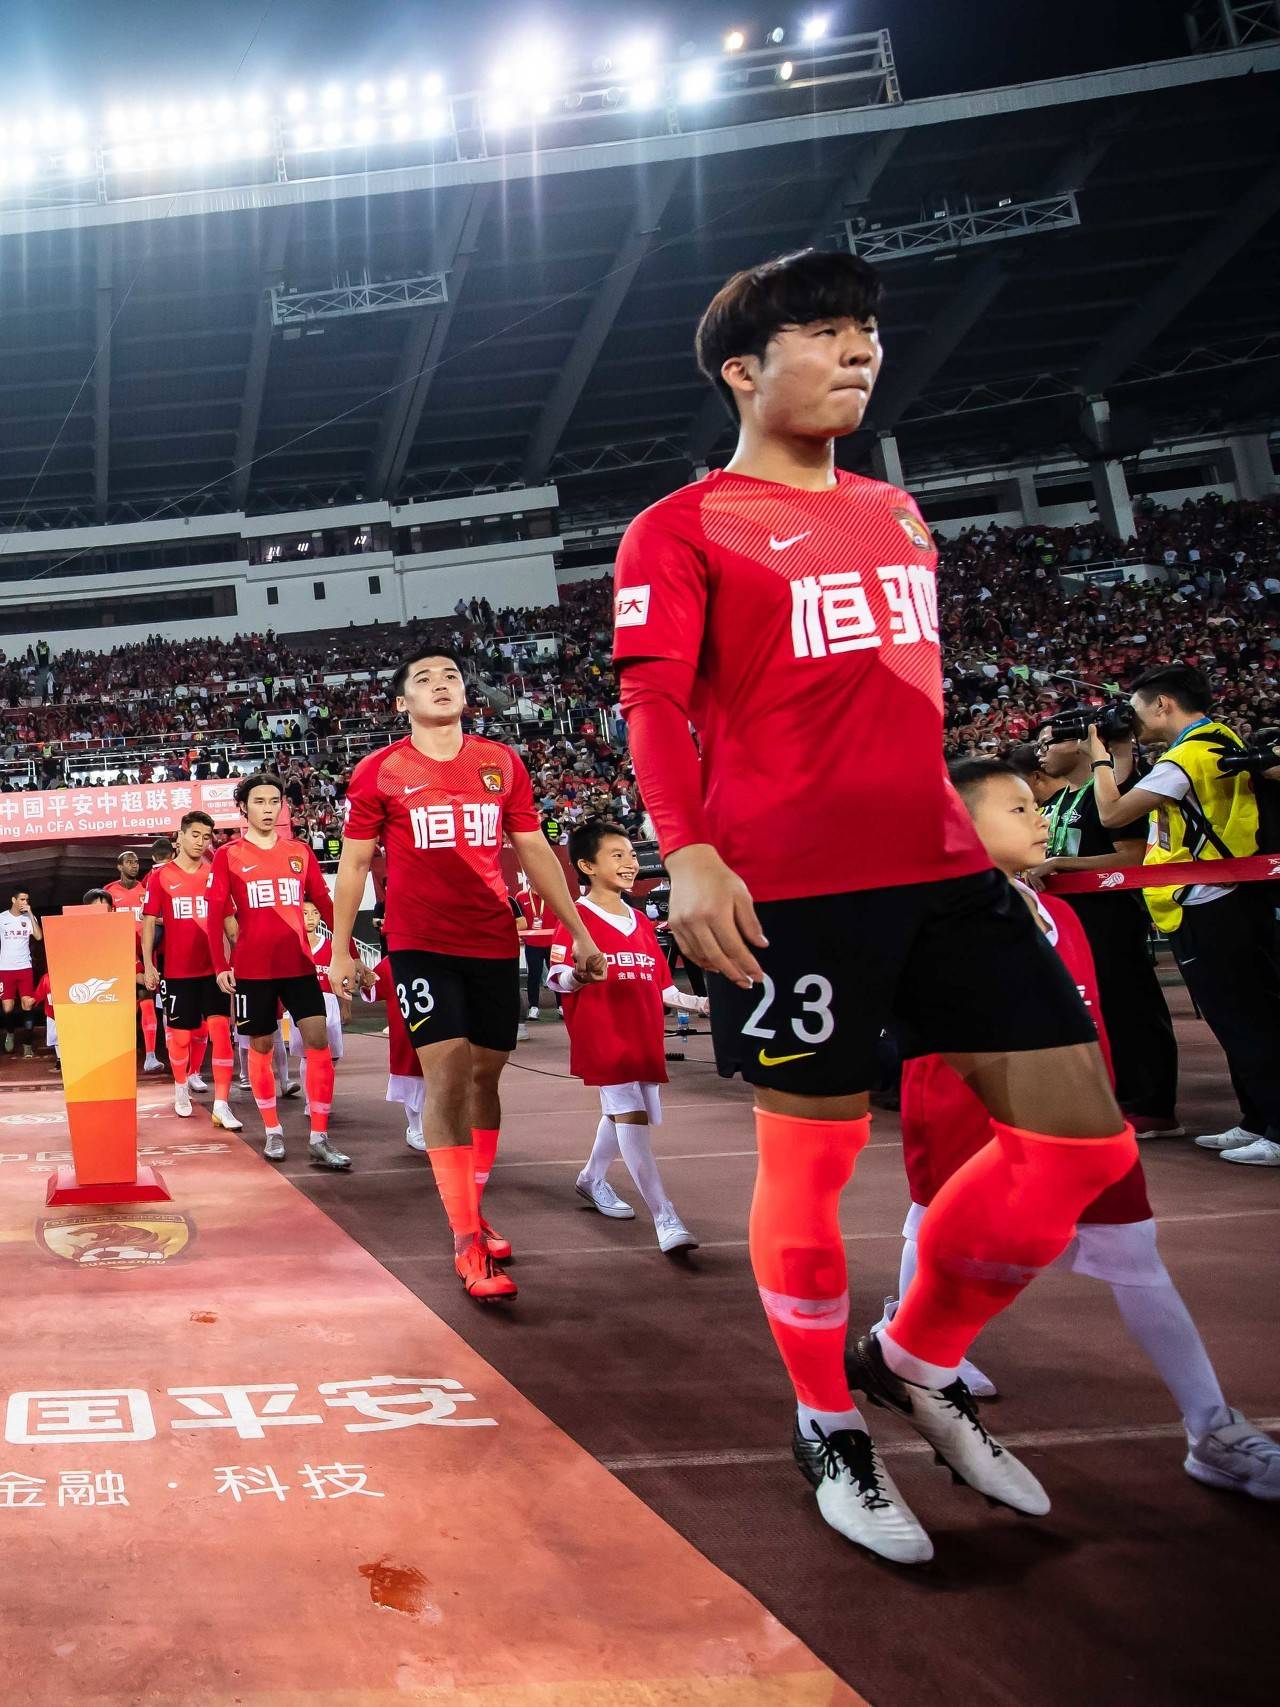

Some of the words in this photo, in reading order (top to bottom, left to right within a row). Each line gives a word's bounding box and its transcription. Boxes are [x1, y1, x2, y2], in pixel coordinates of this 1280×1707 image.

[790, 564, 940, 659] 恒驰
[25, 822, 43, 835] An
[47, 820, 74, 833] CFA
[79, 818, 118, 831] Super
[122, 814, 171, 829] League
[410, 803, 500, 850] 恒驰
[246, 878, 301, 908] 恒驰
[96, 993, 119, 1003] CSL
[170, 995, 176, 1014] 7
[235, 993, 247, 1019] 11
[397, 977, 435, 1020] 33
[741, 972, 835, 1044] 23
